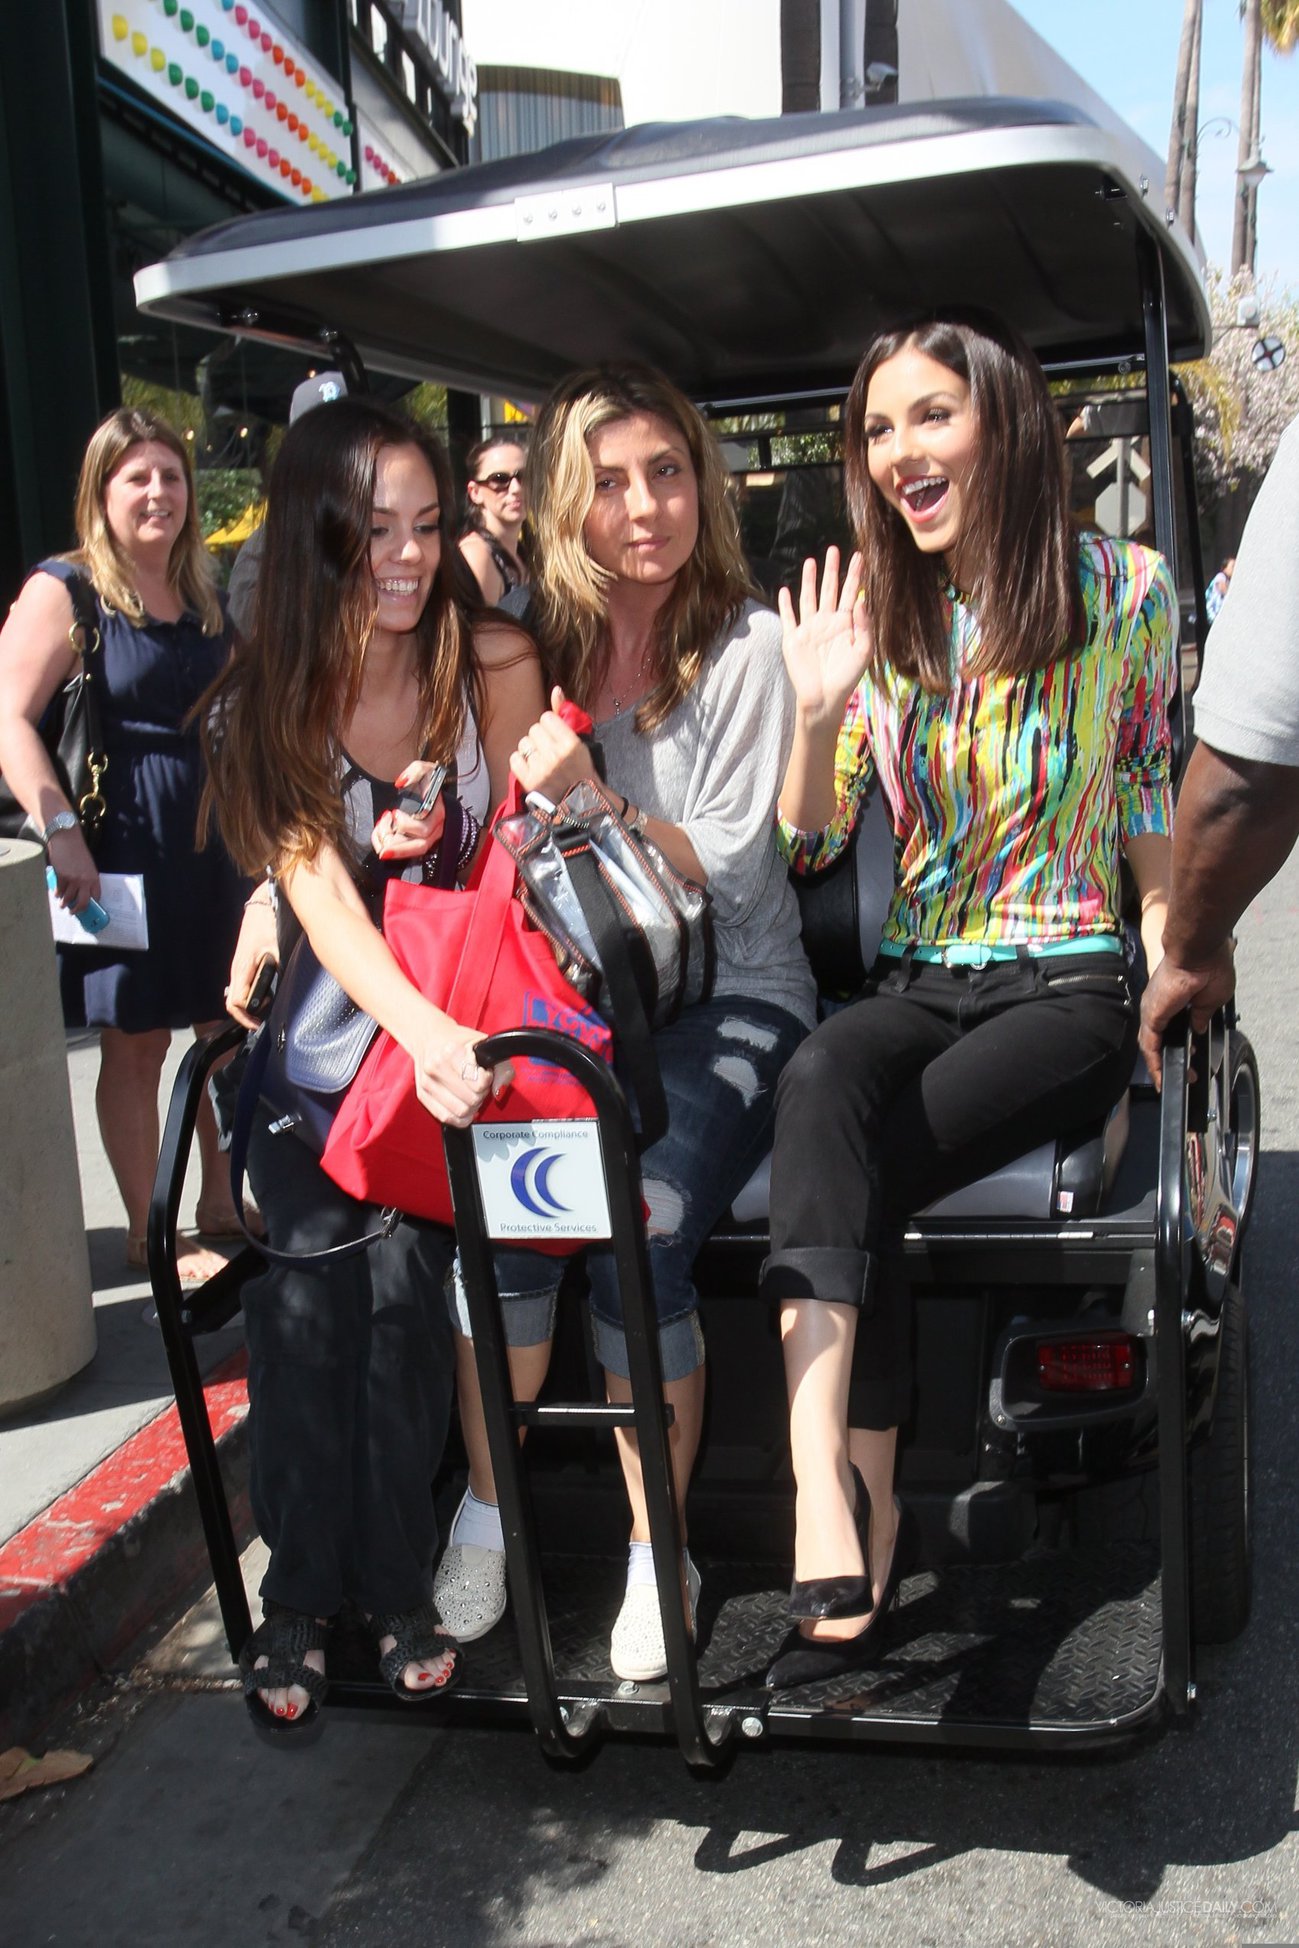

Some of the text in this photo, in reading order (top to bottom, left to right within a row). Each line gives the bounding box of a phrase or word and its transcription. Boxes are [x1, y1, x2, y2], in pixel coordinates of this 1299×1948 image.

[483, 1130, 588, 1140] Corporate Compliance
[500, 1222, 597, 1232] Protective Services
